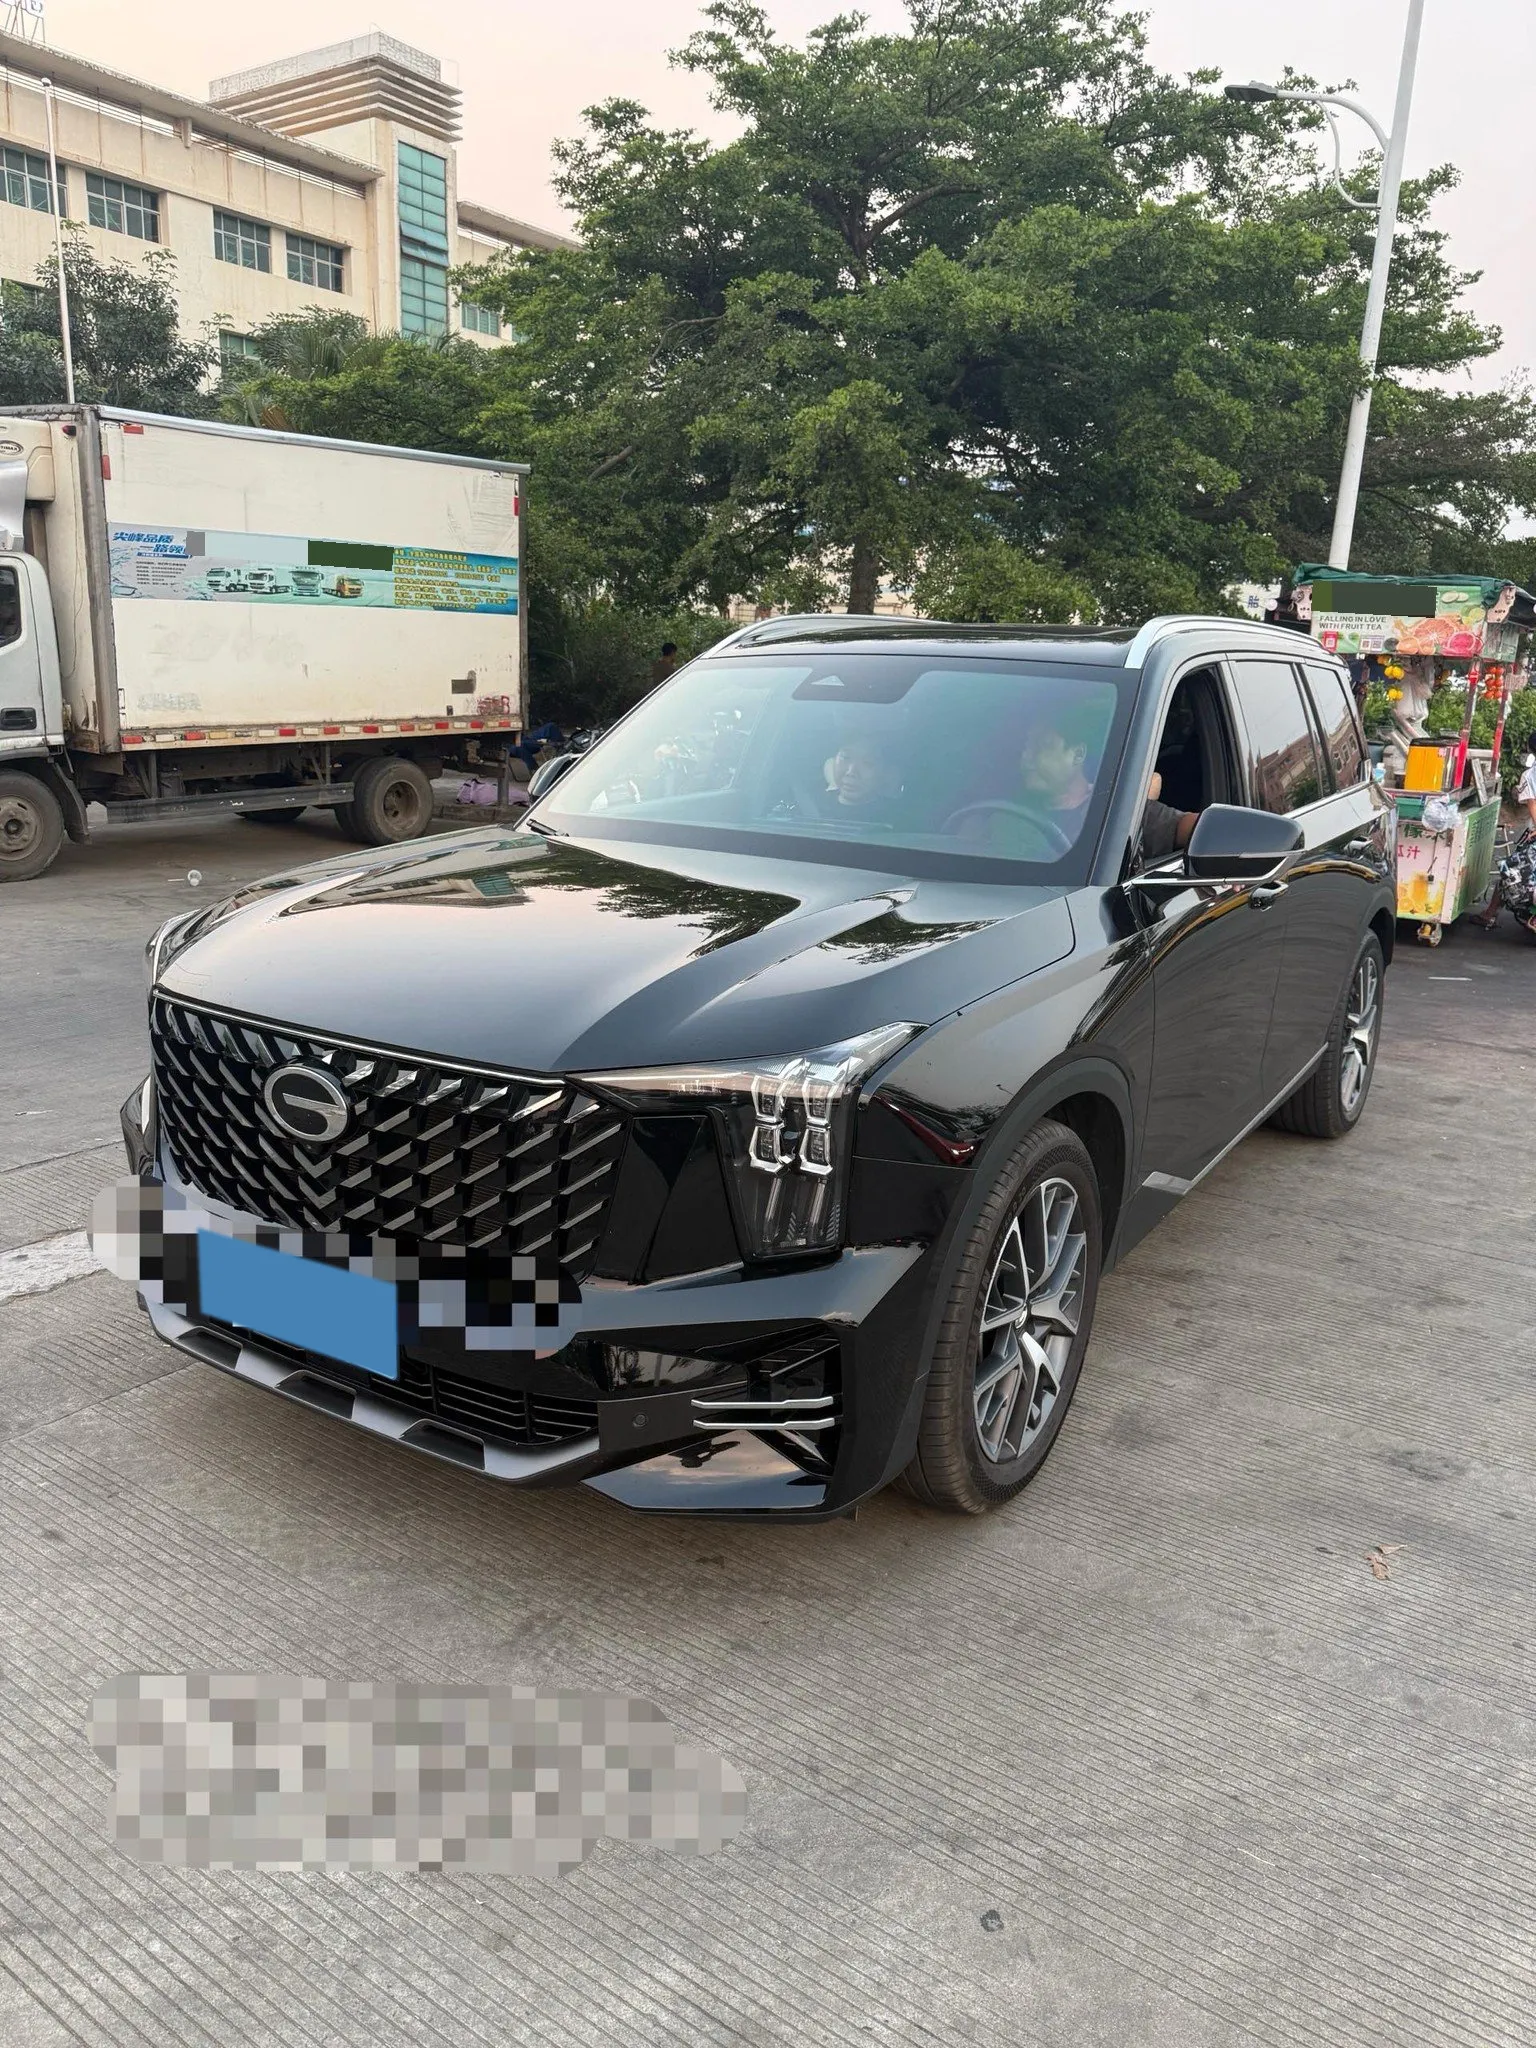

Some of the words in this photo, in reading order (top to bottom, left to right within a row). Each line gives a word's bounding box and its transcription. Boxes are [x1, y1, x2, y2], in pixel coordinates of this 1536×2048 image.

[113, 531, 173, 543] 尖峰品质
[139, 543, 188, 555] 一路领
[1319, 615, 1354, 623] FALLING
